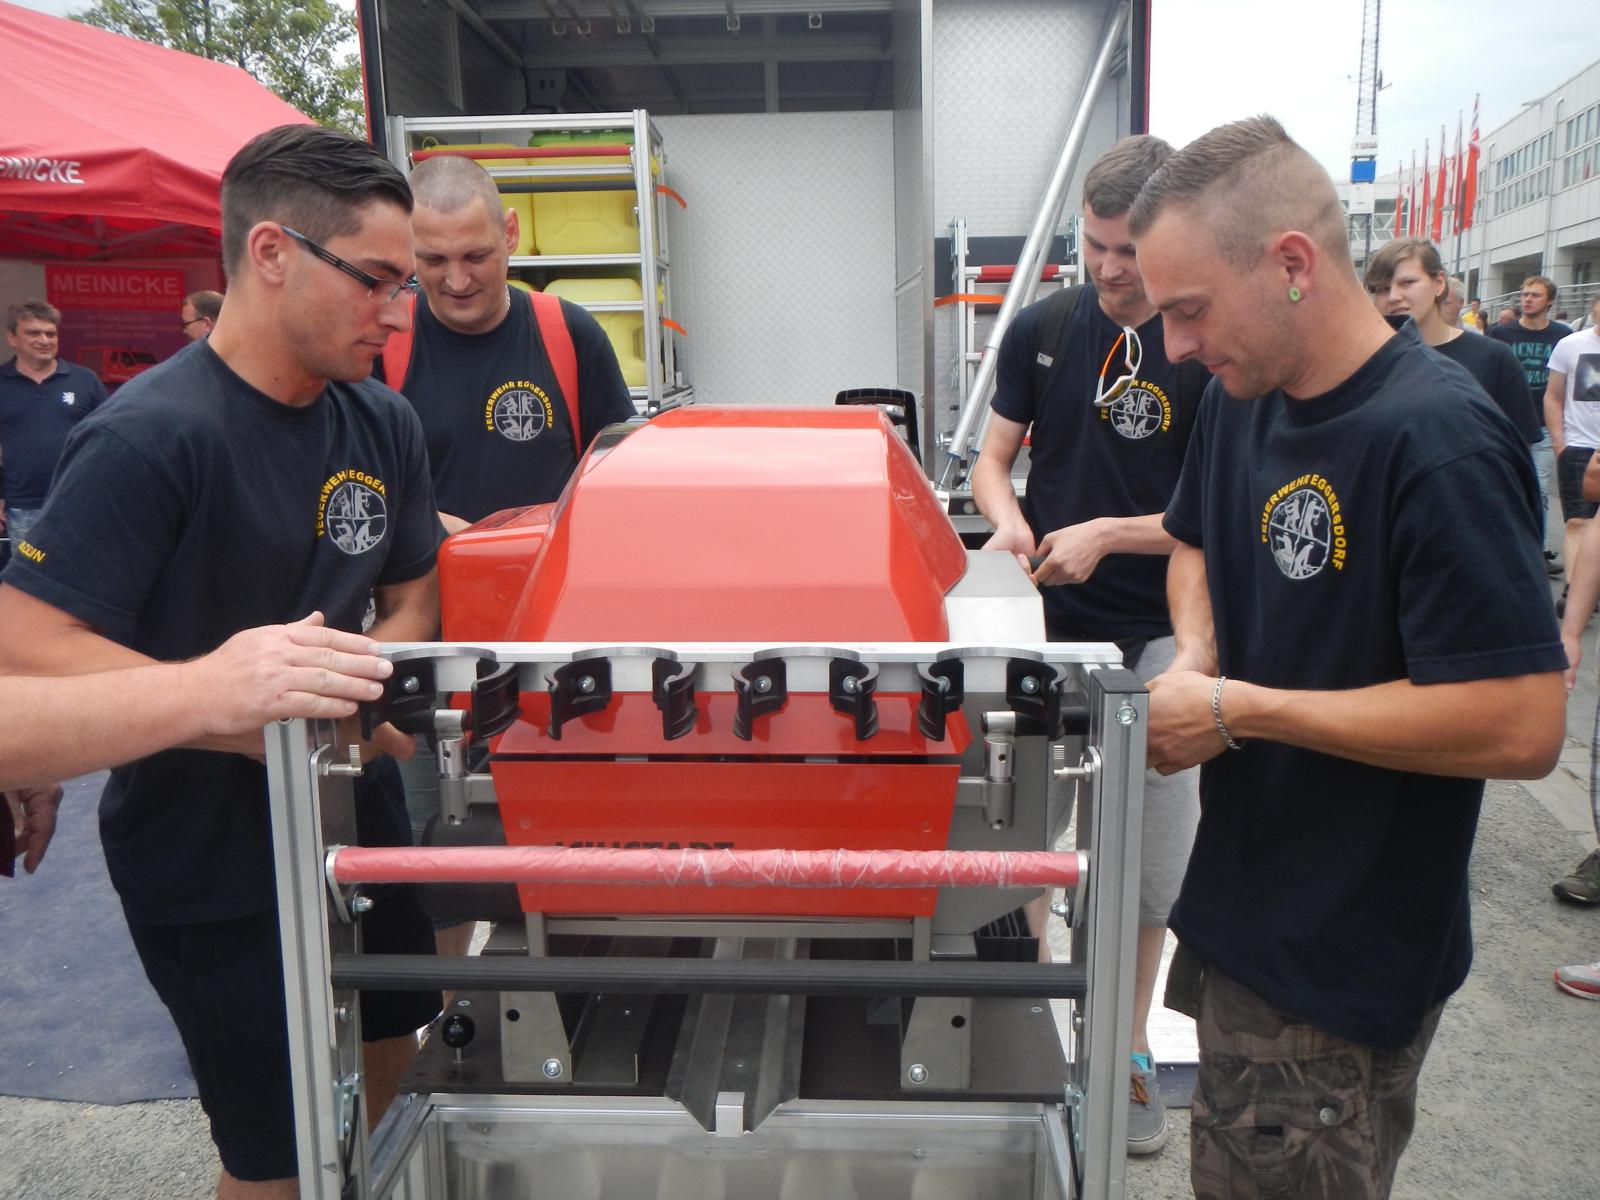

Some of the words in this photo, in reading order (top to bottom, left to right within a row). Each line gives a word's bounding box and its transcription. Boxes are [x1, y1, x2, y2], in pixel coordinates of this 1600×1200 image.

[53, 273, 179, 295] MEINICKE
[485, 381, 515, 431] FEUERWEHR
[517, 380, 553, 429] EGGERSDORF
[1141, 381, 1172, 432] EGGERSDORF
[315, 469, 347, 537] FEUERWEH
[1261, 475, 1310, 543] FEUERWEHR
[1310, 474, 1347, 570] EGGERSDORF
